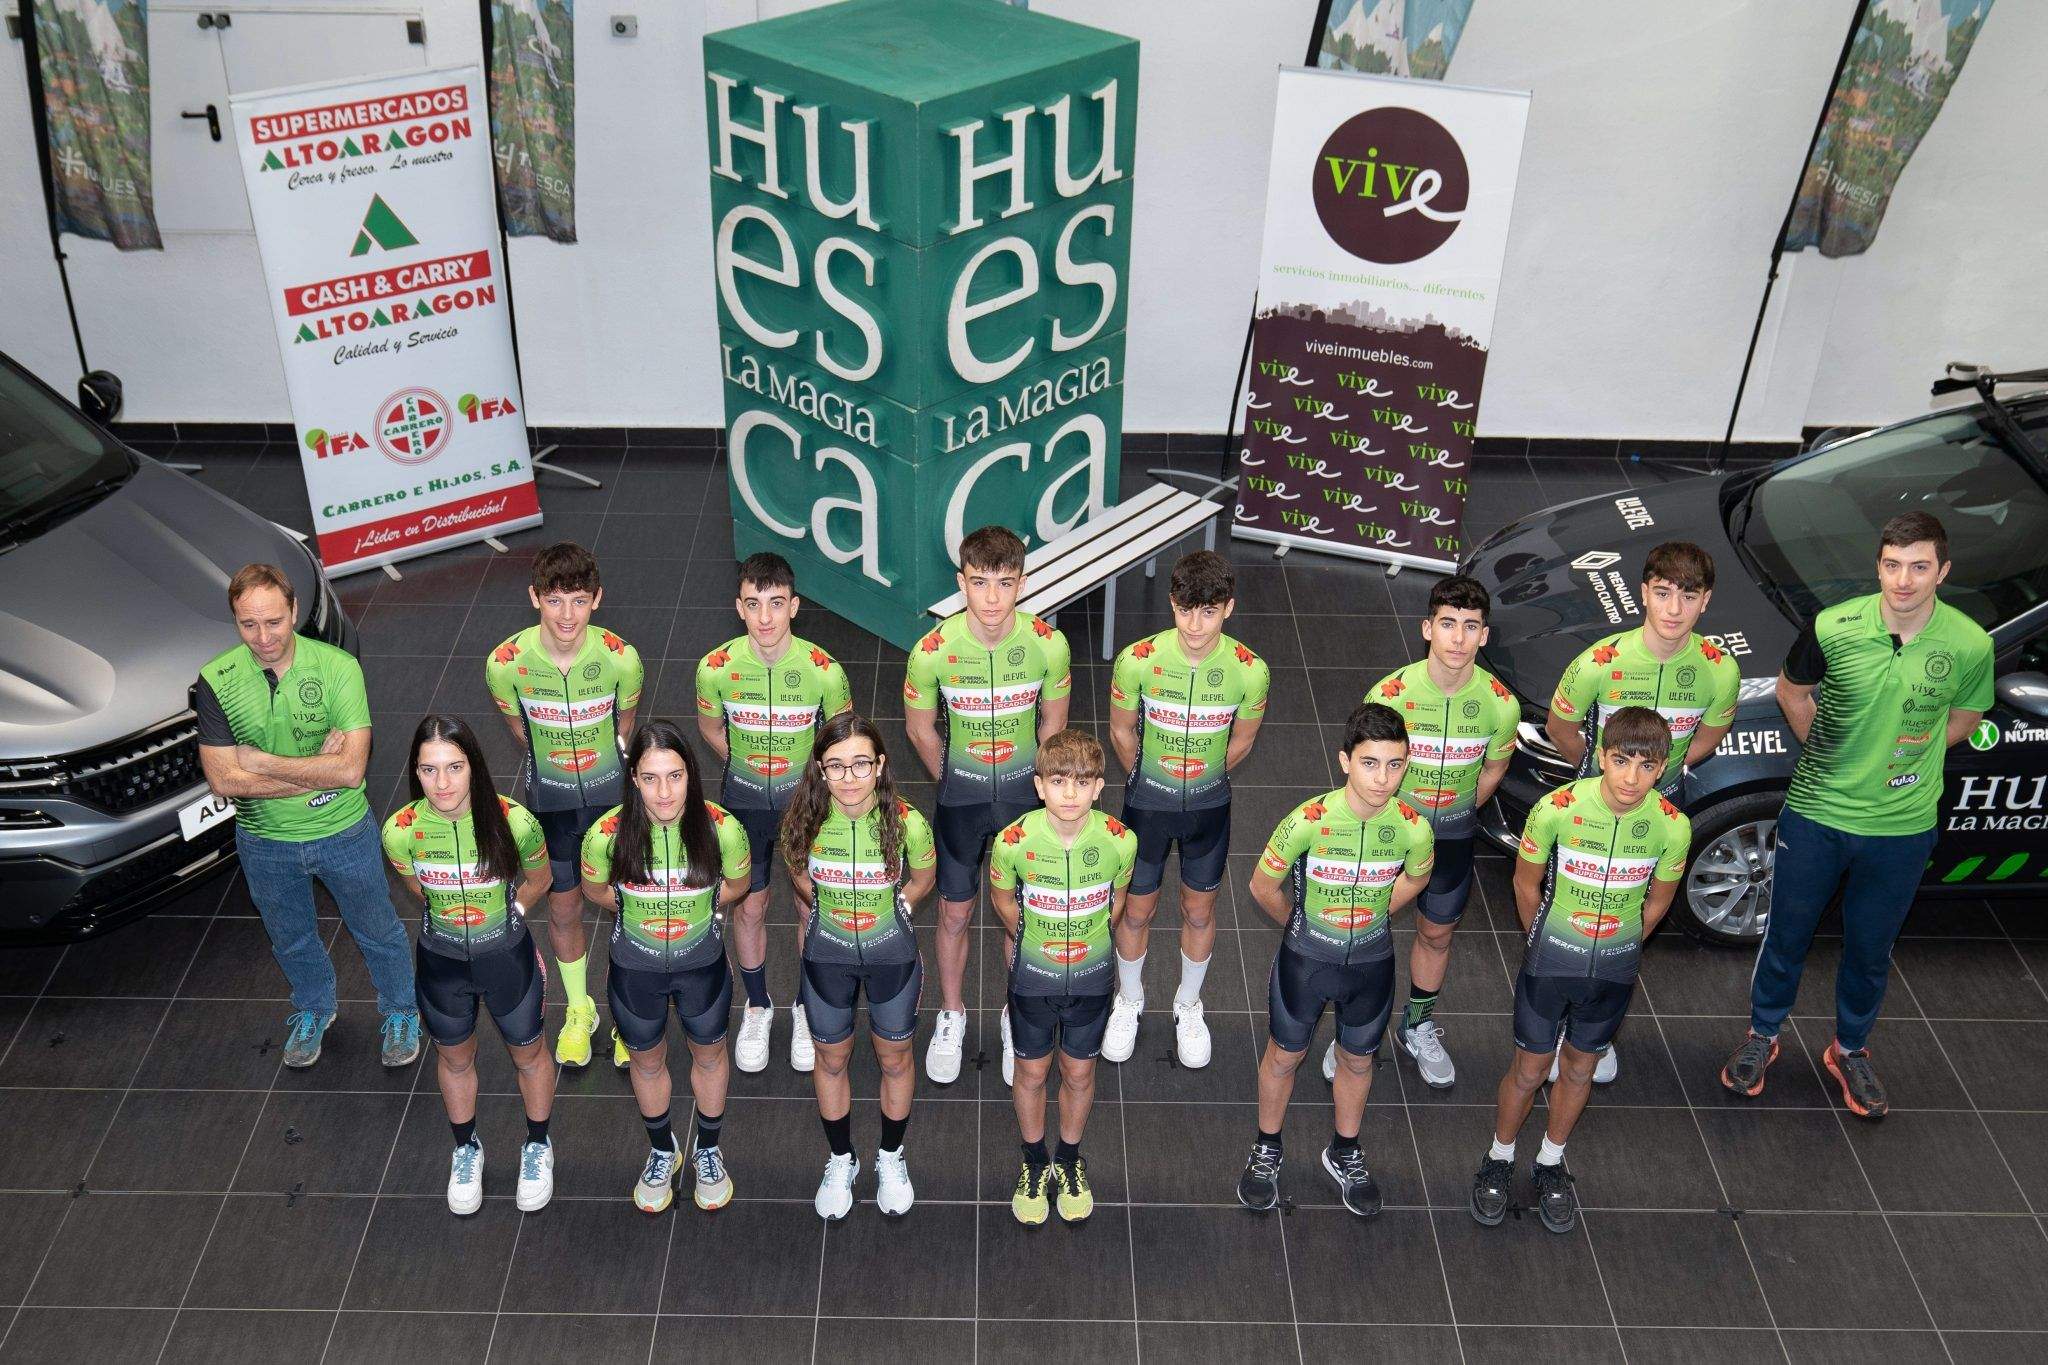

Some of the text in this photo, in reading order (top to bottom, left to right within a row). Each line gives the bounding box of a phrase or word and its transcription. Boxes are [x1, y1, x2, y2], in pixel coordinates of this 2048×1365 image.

[256, 89, 464, 140] SUPERMERCADOS
[260, 118, 472, 172] ALTOARAGON
[708, 70, 881, 231] Hu
[949, 78, 1122, 235] Hu
[288, 151, 453, 190] Cerca y fresco. Lo nuestro
[1324, 147, 1466, 222] vive
[302, 257, 474, 308] CASH & CARRY
[717, 204, 882, 381] es
[947, 204, 1117, 383] es
[1273, 264, 1325, 280] servicios
[1423, 282, 1486, 302] diferentes
[294, 285, 495, 344] ALTOARAGON
[333, 327, 459, 365] Calidad y Servicio
[1306, 339, 1433, 370] viveinmuebles.com
[1259, 359, 1314, 385] vive
[1337, 372, 1393, 397] vive
[1294, 395, 1349, 421] vive
[1417, 382, 1473, 409] vive
[384, 416, 443, 436] CABRERO
[406, 397, 423, 455] CABRERO
[1253, 418, 1307, 443] vive
[1372, 407, 1428, 434] vive
[1330, 430, 1385, 456] vive
[1408, 442, 1464, 468] vive
[1287, 453, 1341, 479] vive
[1365, 465, 1419, 491] vive
[323, 491, 407, 517] CABRERO
[414, 487, 423, 496] E
[491, 459, 524, 476] S.A.
[729, 409, 892, 587] ca
[1248, 475, 1300, 500] vive
[1323, 487, 1377, 513] vive
[405, 524, 419, 536] en
[422, 496, 507, 531] Distribución!
[1281, 509, 1334, 534] vive
[1400, 500, 1455, 526] vive
[1356, 522, 1411, 547] vive
[1587, 571, 1622, 624] AUTO CUATRO
[1607, 571, 1639, 615] RENAULT
[1912, 683, 1943, 697] vive
[293, 711, 325, 723] vive
[540, 711, 607, 722] SUPERMERCADOS
[960, 701, 1029, 710] SUPERMERCADOS
[540, 727, 600, 740] Huesca
[961, 718, 1019, 730] Huesca
[1157, 716, 1224, 727] SUPERMERCADOS
[2012, 719, 2028, 730] Top
[741, 734, 795, 745] Huesca
[966, 745, 1017, 756] adrenalina
[1156, 733, 1211, 746] Huesca
[547, 752, 601, 765] adrenalina
[745, 759, 793, 770] adrenalina
[1158, 759, 1208, 771] adrenalina
[1411, 750, 1479, 760] SUPERMERCADOS
[1410, 768, 1466, 779] Huesca
[311, 792, 338, 805] vulco
[1410, 791, 1460, 801] adrenalina
[1574, 868, 1644, 881] SUPERMERCADOS
[824, 890, 882, 901] Huesca
[1318, 886, 1382, 897] Huesca
[1570, 887, 1630, 903] Huesca
[636, 900, 696, 910] Huesca
[1036, 900, 1102, 910] SUPERMERCADOS
[1318, 913, 1376, 922] adrenalina
[640, 923, 692, 932] adrenalina
[829, 914, 880, 924] adrenalina
[1037, 919, 1093, 930] Huesca
[1567, 916, 1623, 930] adrenalina
[1039, 944, 1092, 956] adrenalina
